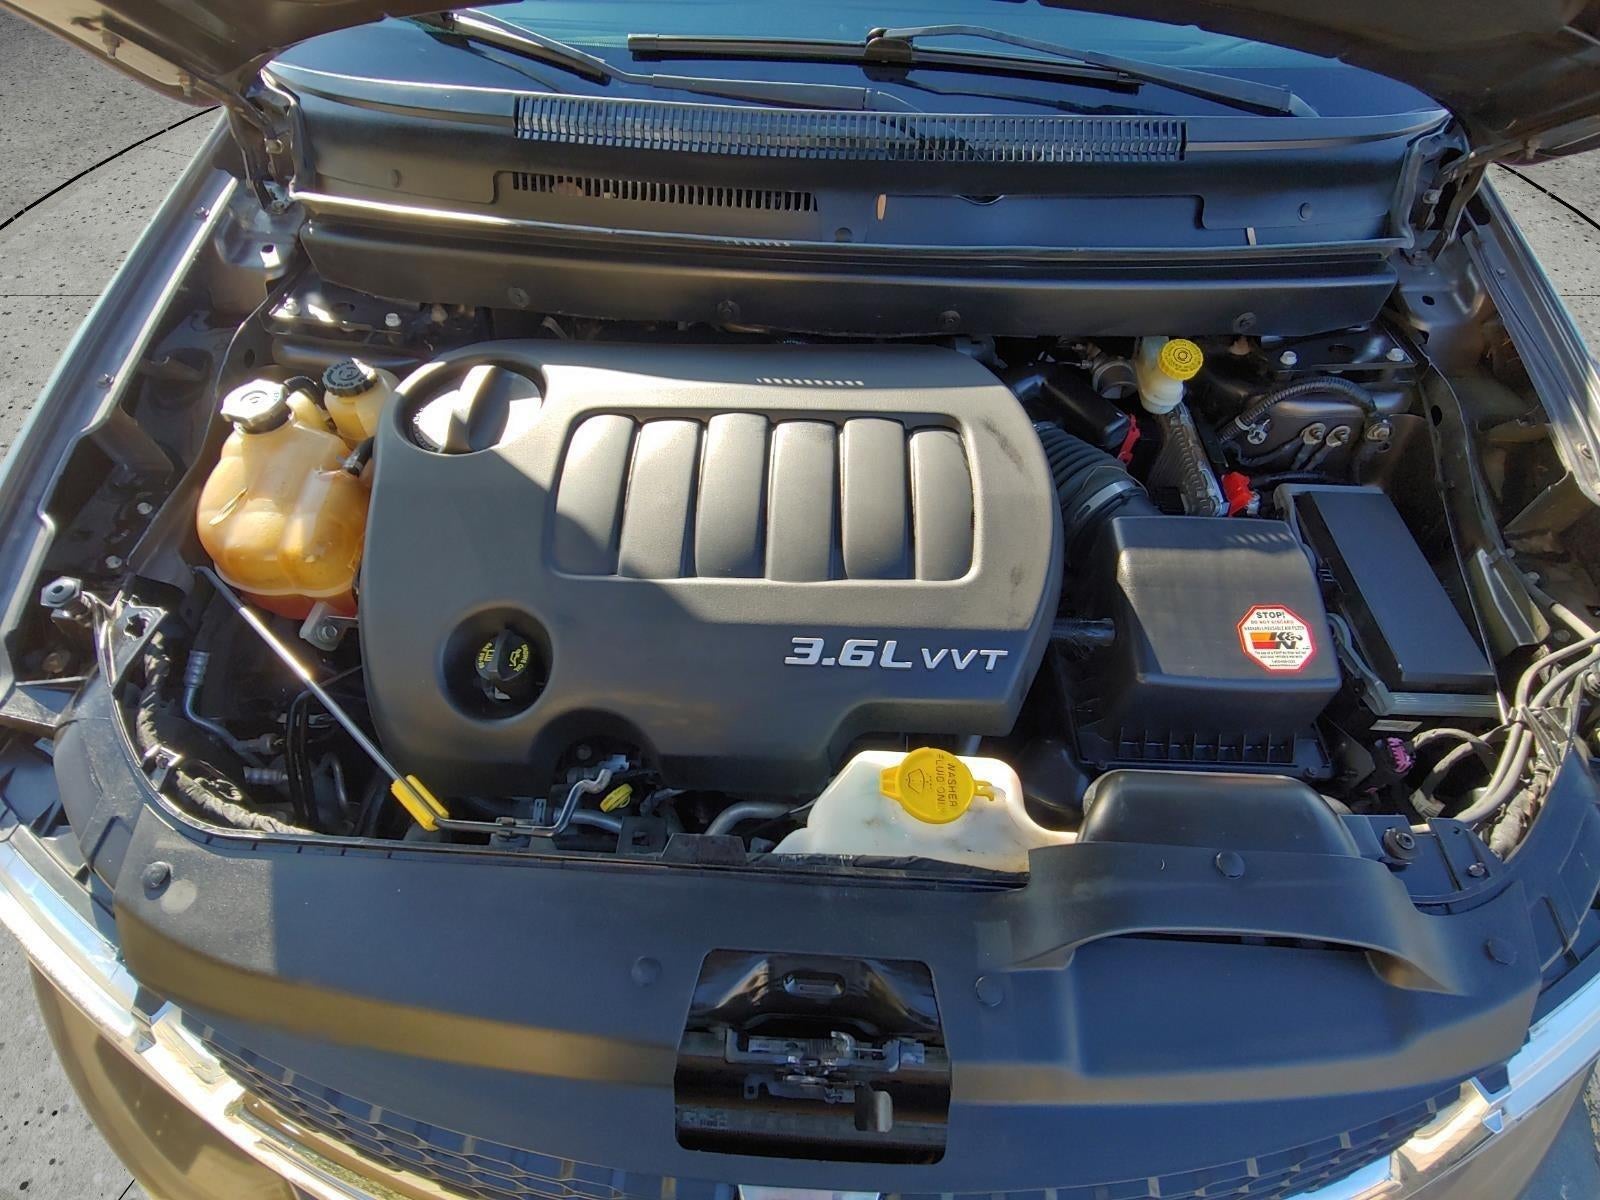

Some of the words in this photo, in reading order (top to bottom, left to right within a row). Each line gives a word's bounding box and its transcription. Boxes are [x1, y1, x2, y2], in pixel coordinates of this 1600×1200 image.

[1256, 611, 1286, 619] STOP!
[784, 637, 913, 669] 3.6L
[921, 648, 1009, 671] VVT
[947, 763, 958, 807] WASHER
